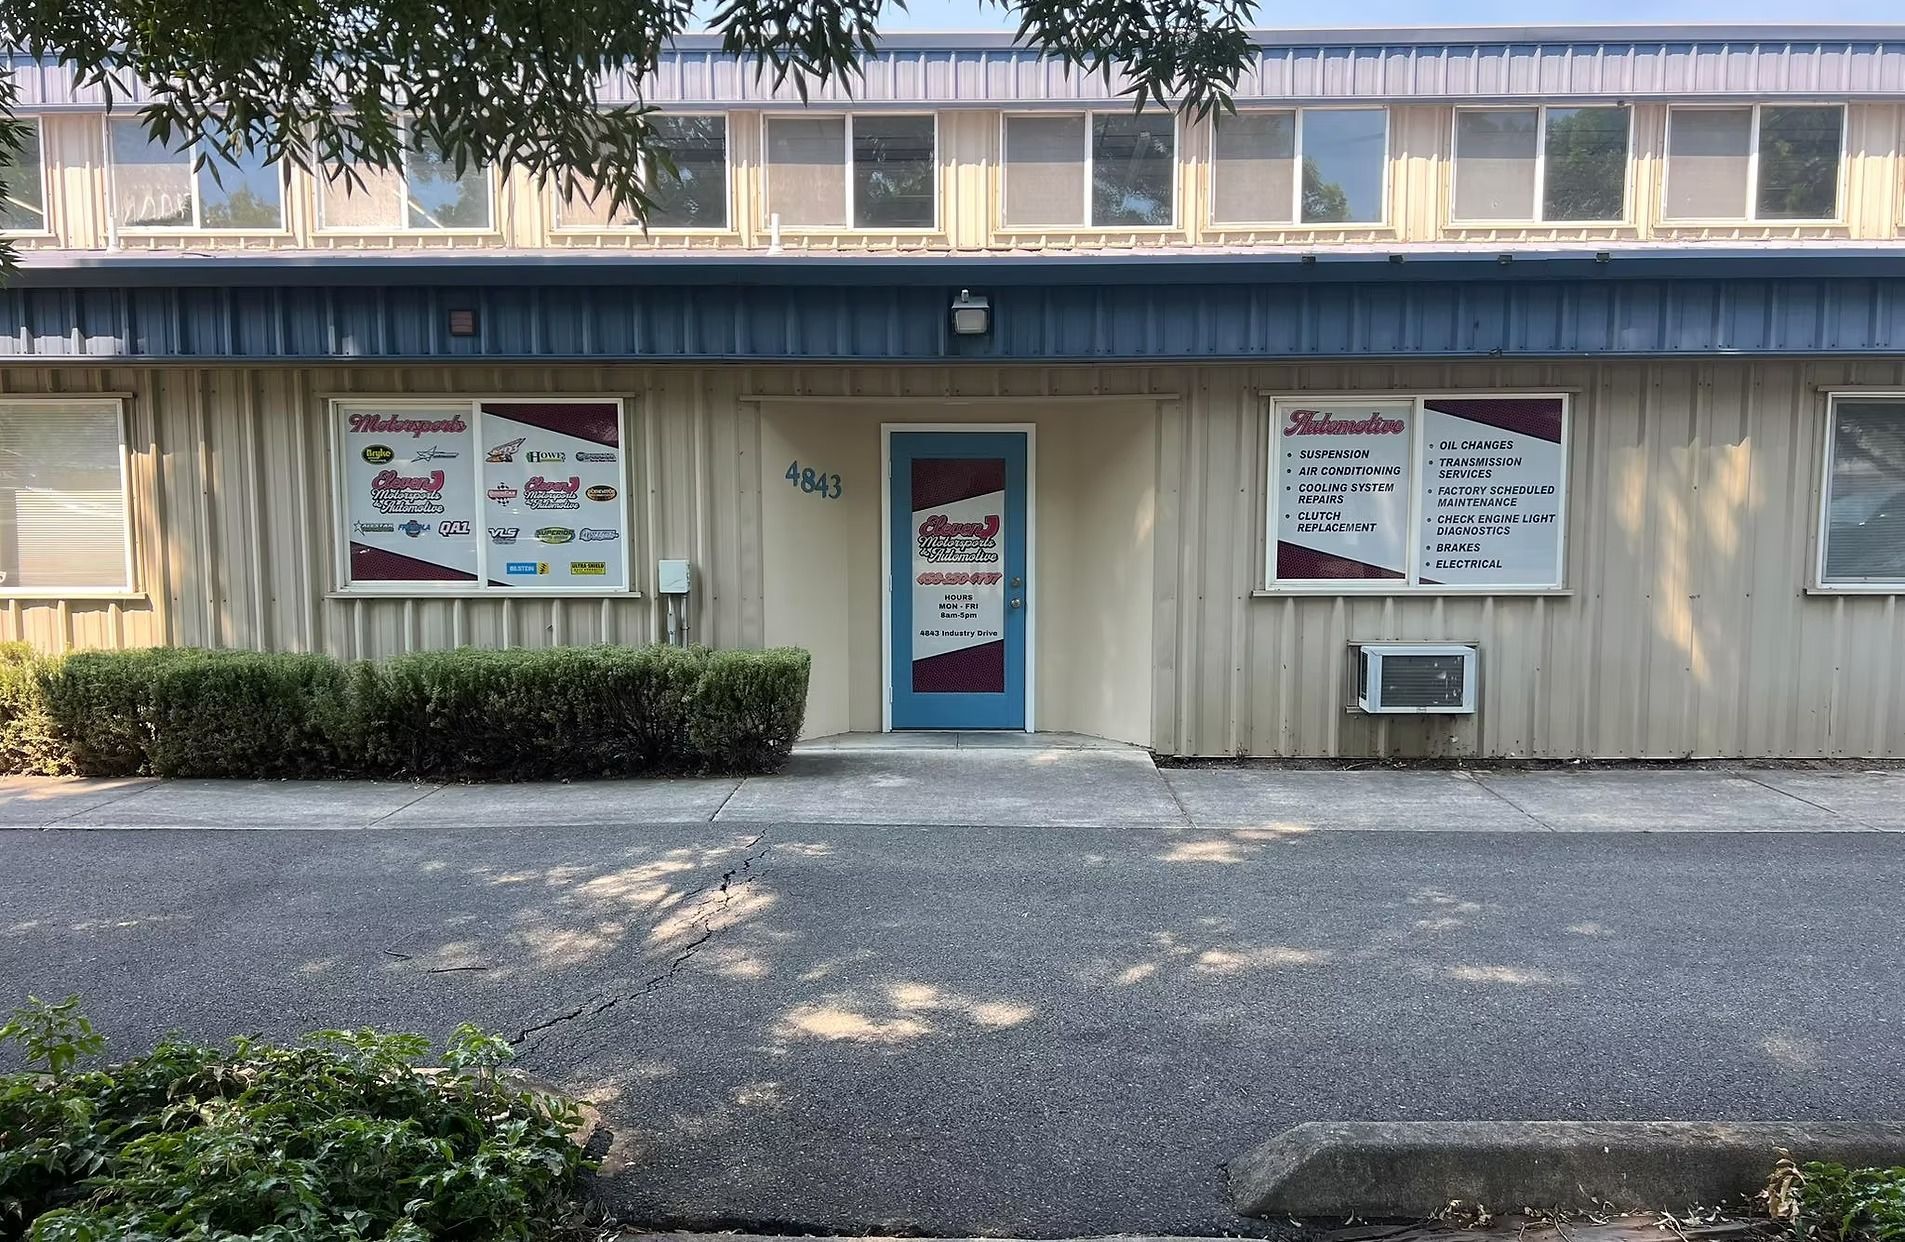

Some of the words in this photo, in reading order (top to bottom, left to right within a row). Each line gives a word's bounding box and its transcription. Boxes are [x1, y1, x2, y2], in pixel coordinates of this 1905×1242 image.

[348, 413, 467, 439] Motorsports
[1283, 409, 1406, 437] Automotive
[1440, 440, 1457, 450] OIL
[1461, 440, 1514, 450] CHANGES
[1299, 449, 1370, 459] SUSPENSION
[1440, 457, 1522, 467] TRANSMISSION
[1299, 466, 1318, 476] AIR
[1320, 466, 1401, 476] CONDITIONING
[1438, 469, 1492, 479] SERVICES
[372, 470, 432, 491] Eleven
[785, 460, 842, 499] 4843
[1298, 483, 1348, 493] COOLING
[1350, 483, 1395, 493] SYSTEM
[1438, 486, 1487, 496] FACTORY
[1489, 486, 1555, 495] SCHEDULED
[371, 489, 442, 503] Motorsports
[524, 491, 577, 503] Motorsports
[1298, 495, 1344, 504] REPAIRS
[380, 499, 445, 514] Automotive
[530, 500, 580, 510] Automotive
[1437, 498, 1518, 508] MAINTENANCE
[1298, 511, 1341, 521] CLUTCH
[1437, 515, 1475, 524] CHECK
[1478, 515, 1520, 524] ENGINE
[1522, 514, 1556, 524] LIGHT
[439, 521, 470, 537] QA1
[919, 515, 984, 537] Eleven
[1297, 523, 1377, 532] REPLACEMENT
[1436, 526, 1511, 536] DIAGNOSTICS
[488, 528, 519, 538] VLS
[918, 537, 996, 552] Motorsports
[1436, 543, 1480, 553] BRAKES
[927, 547, 998, 563] Automotive
[1435, 560, 1502, 569] ELECTRICAL
[940, 611, 977, 619] 8am-5pm
[942, 629, 976, 638] Industry
